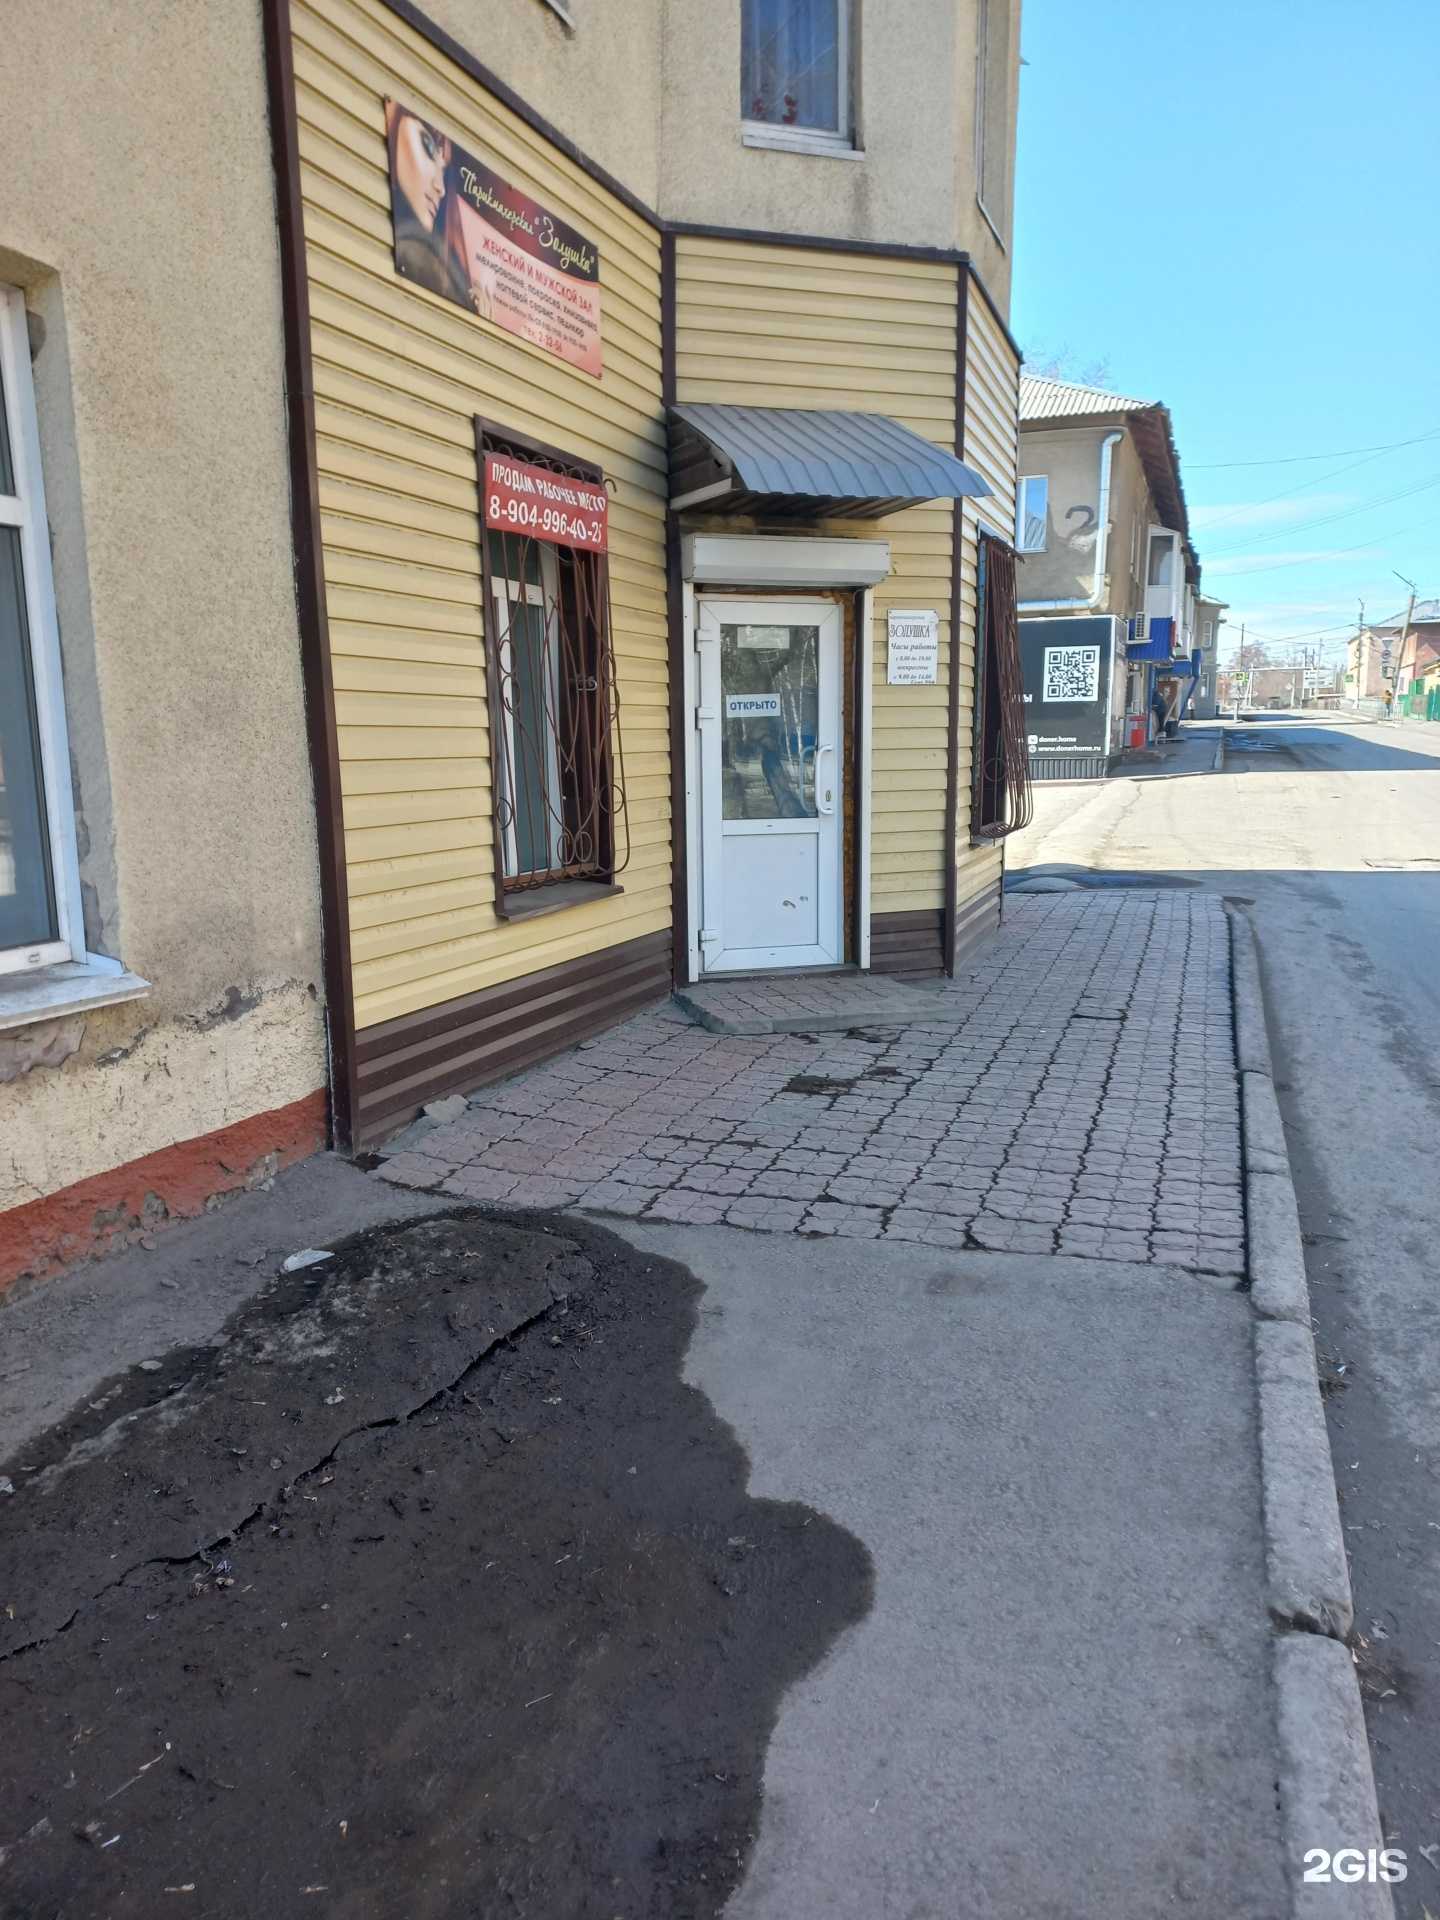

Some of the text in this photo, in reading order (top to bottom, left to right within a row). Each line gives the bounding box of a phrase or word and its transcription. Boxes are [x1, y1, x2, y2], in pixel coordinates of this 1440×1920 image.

[482, 238, 593, 313] ЖЕНСКИЙ И МУЖСКОЙ ЗАЛ
[492, 462, 606, 513] ПРОДАМ РАБОЧЕЕ МЕСТО
[910, 642, 937, 652] работы
[730, 700, 777, 711] ОТКРЫТО
